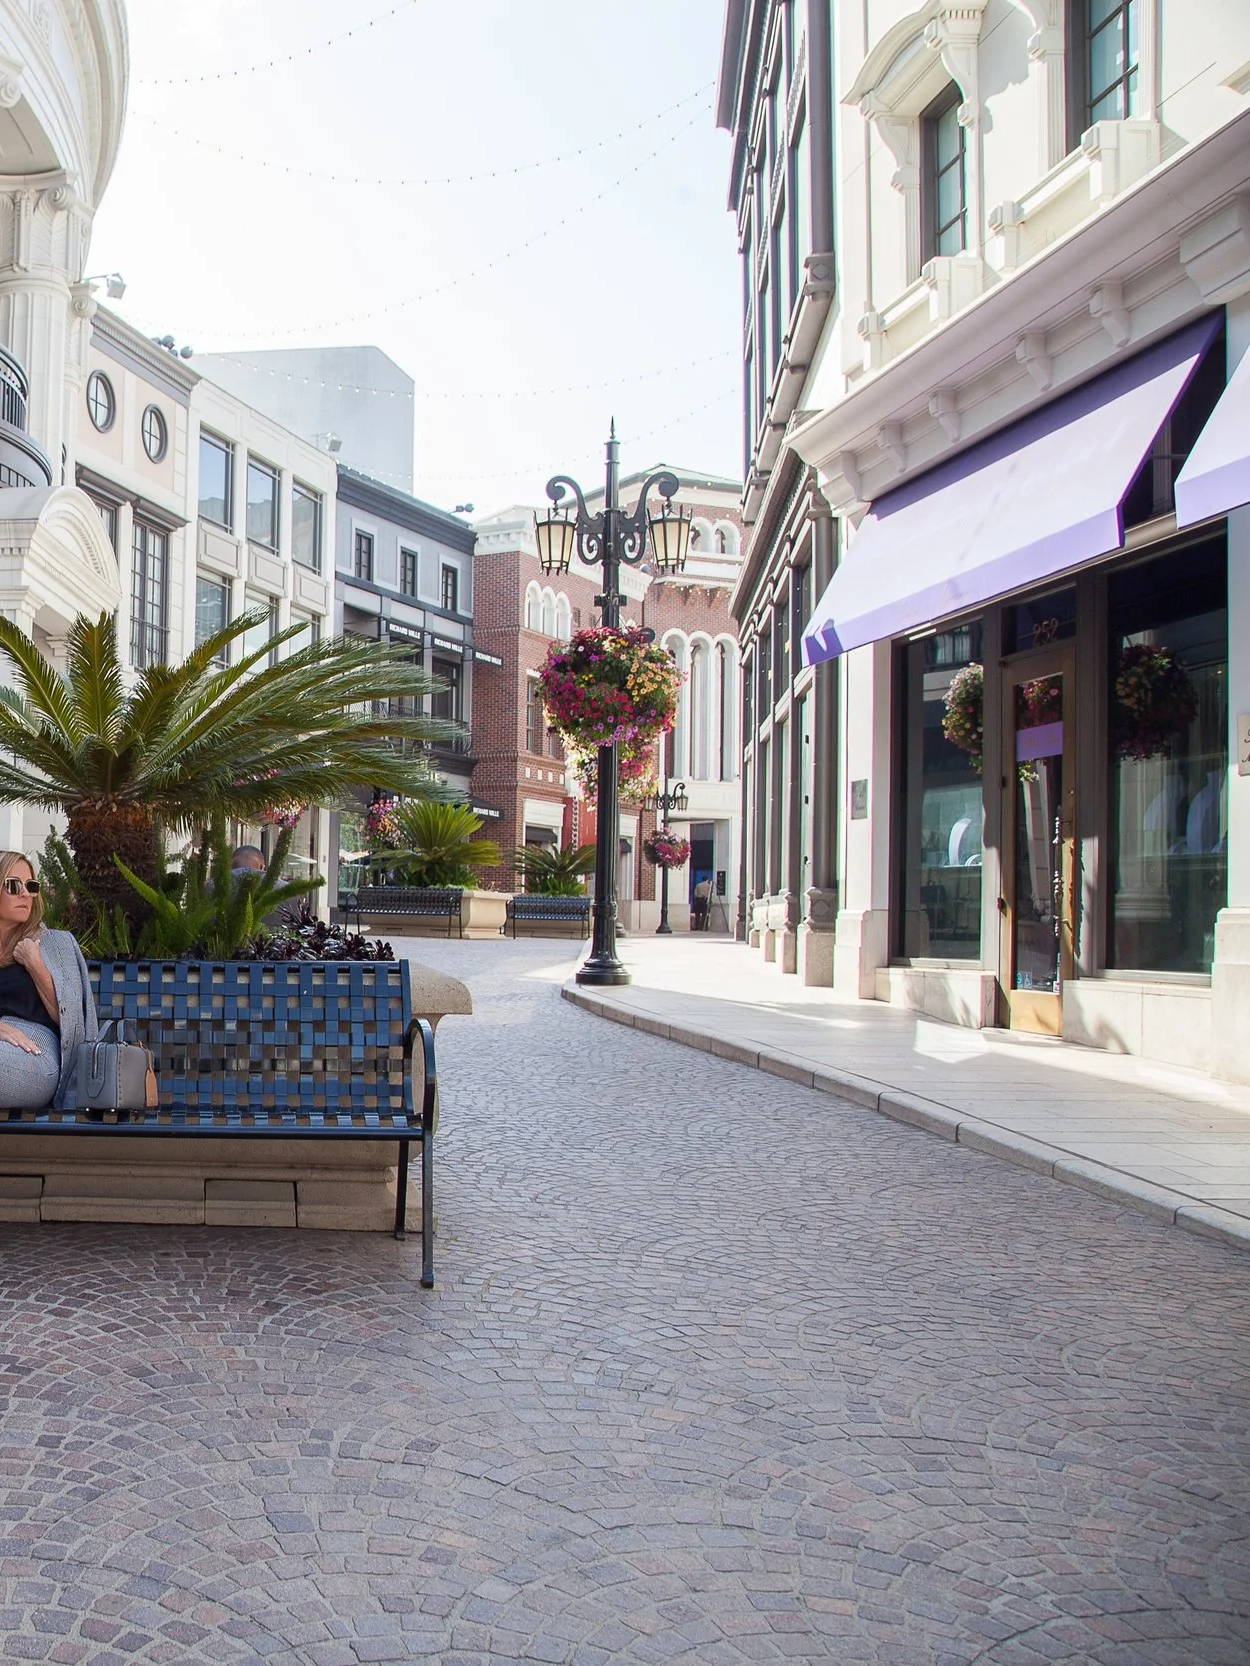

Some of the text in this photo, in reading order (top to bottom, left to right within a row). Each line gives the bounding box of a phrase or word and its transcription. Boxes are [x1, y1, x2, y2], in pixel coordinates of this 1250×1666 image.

[390, 623, 421, 640] RICHARD MILLE
[434, 637, 463, 653] RICHARD MILLE
[475, 651, 502, 666] RICHARD MILLE
[473, 806, 499, 818] RICHARD MILLE
